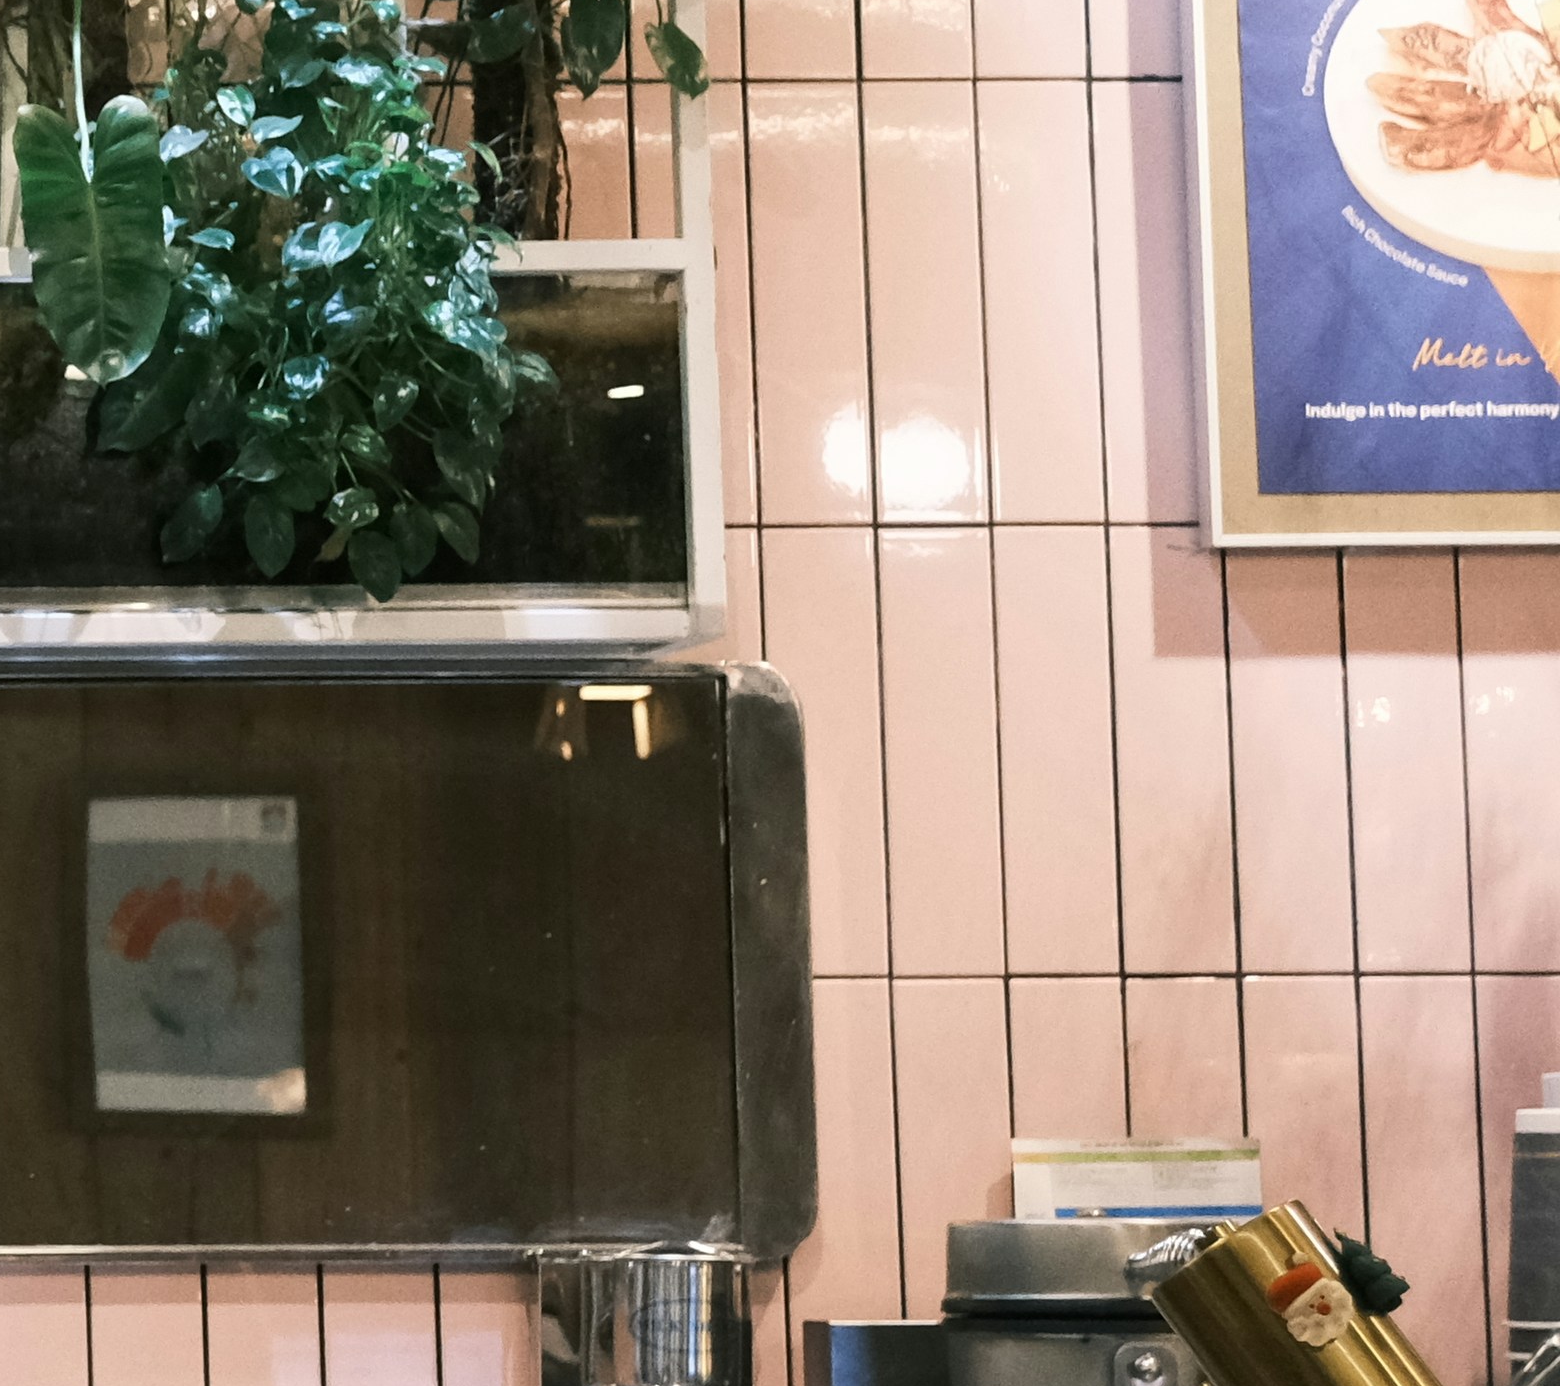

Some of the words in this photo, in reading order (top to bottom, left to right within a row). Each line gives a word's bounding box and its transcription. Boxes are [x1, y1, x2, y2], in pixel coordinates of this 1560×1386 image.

[1364, 227, 1426, 275] Chocolate
[1425, 262, 1469, 288] Sauce
[1411, 336, 1489, 372] Melt
[1495, 348, 1533, 367] in
[1305, 401, 1367, 422] Indulge
[1369, 401, 1385, 419] in
[1387, 400, 1418, 419] the
[1419, 400, 1484, 421] perfect
[1486, 399, 1560, 421] harmony
